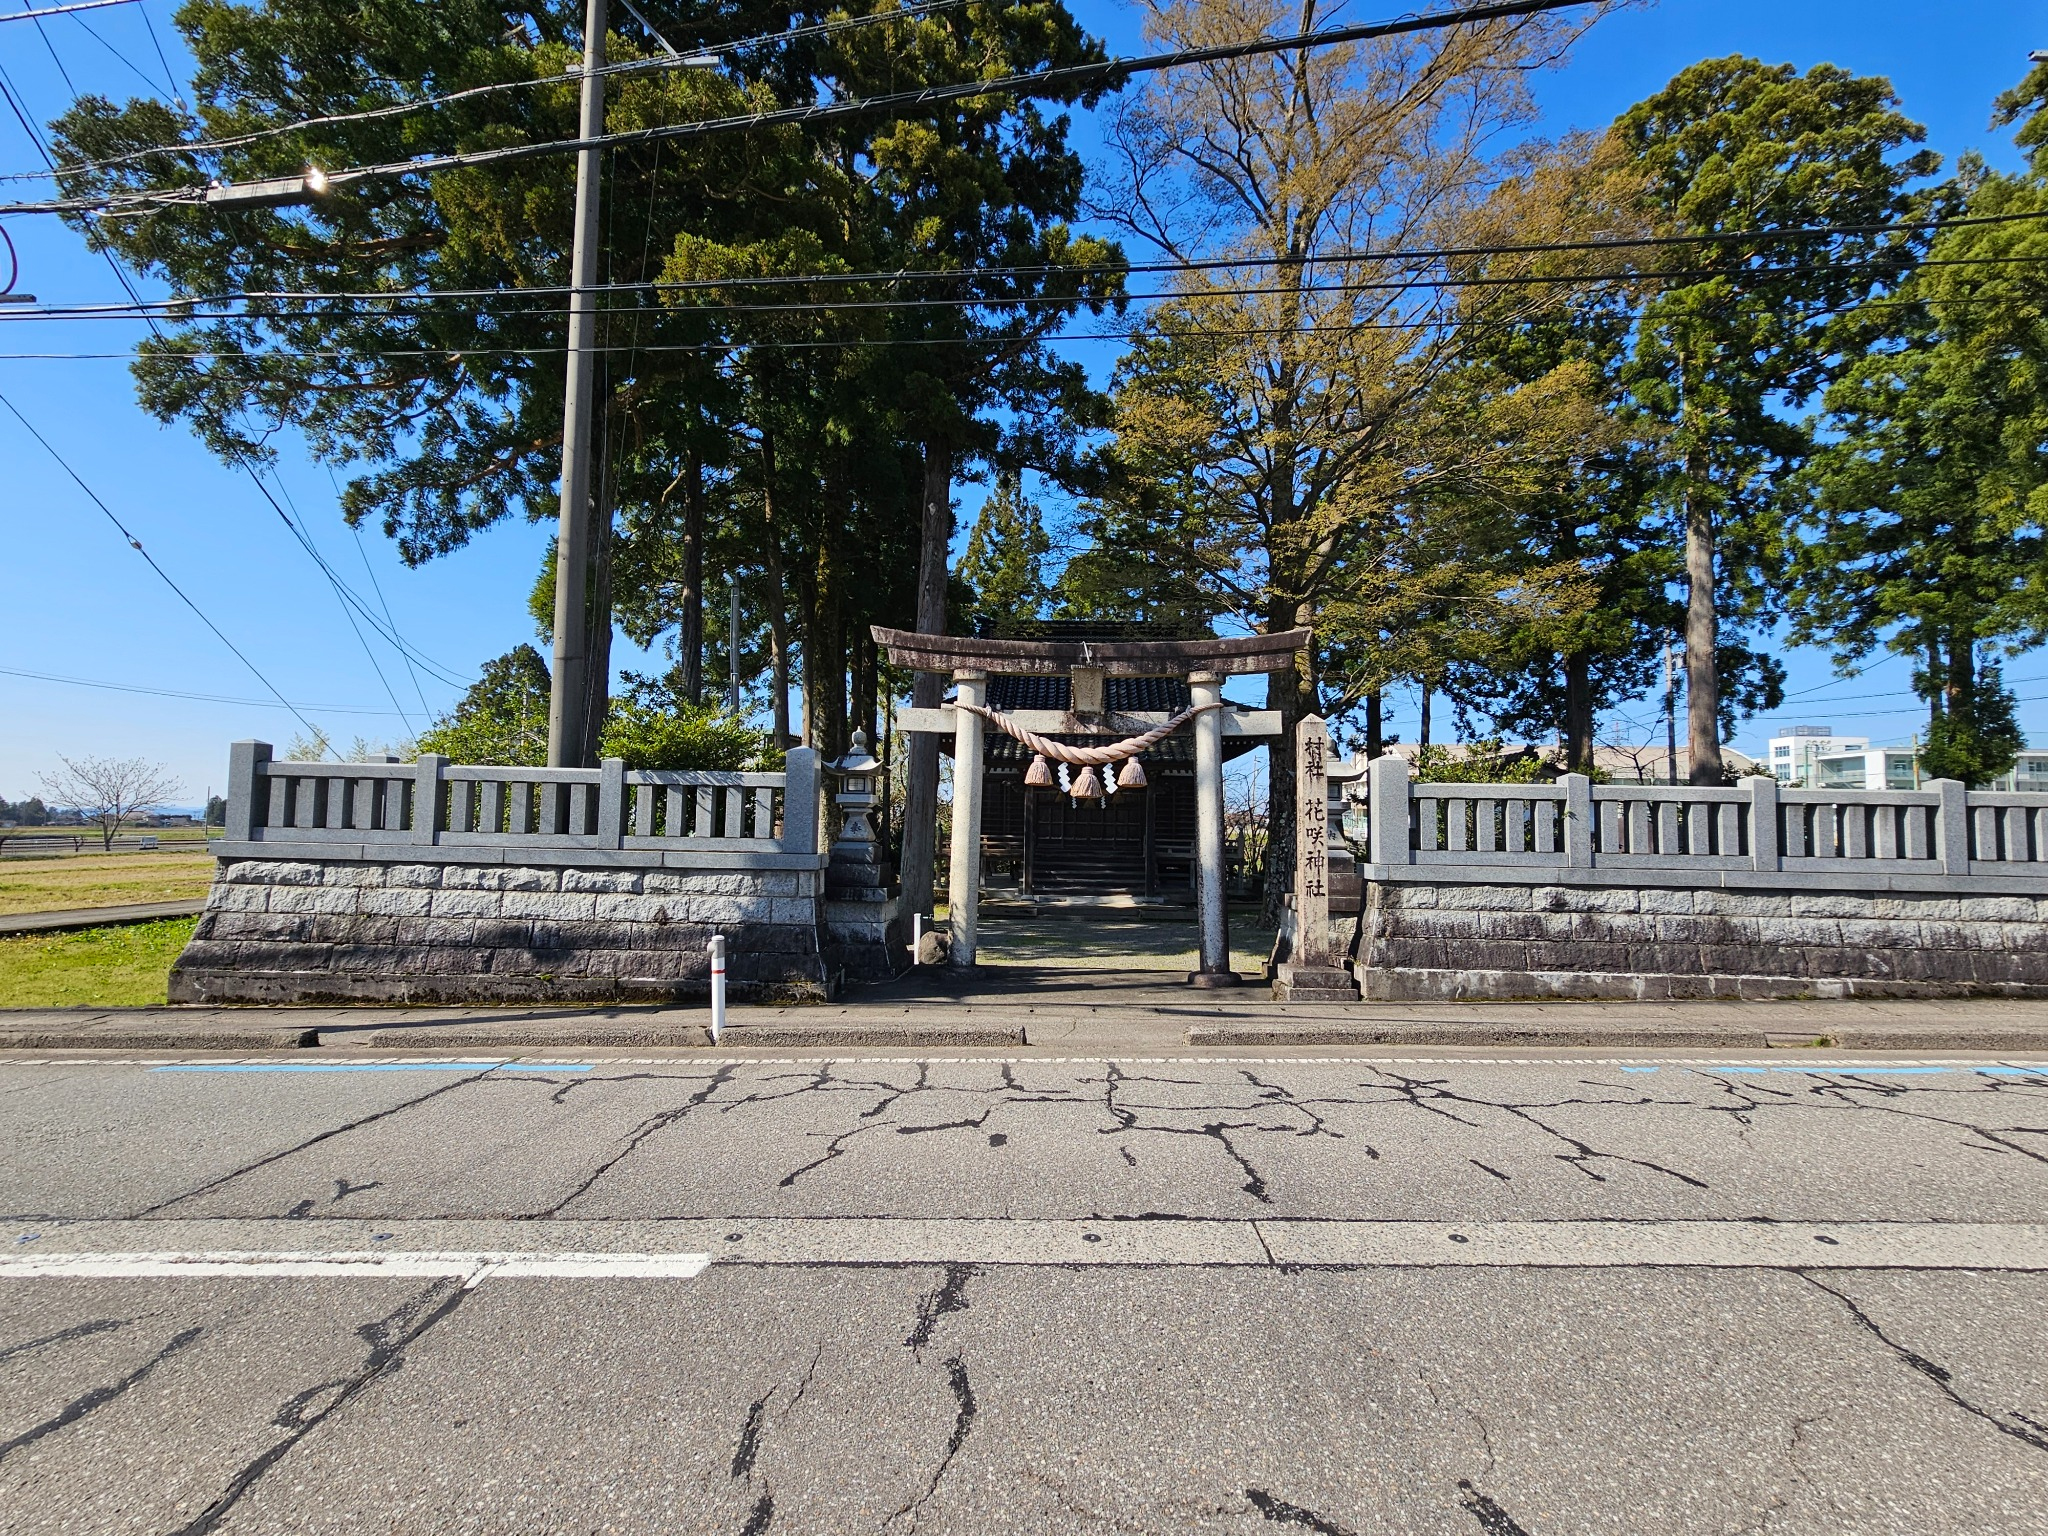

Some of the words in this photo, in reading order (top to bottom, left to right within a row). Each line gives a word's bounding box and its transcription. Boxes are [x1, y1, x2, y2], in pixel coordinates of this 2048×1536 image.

[1305, 736, 1325, 780] 村社
[1305, 798, 1326, 897] 花咲神社
